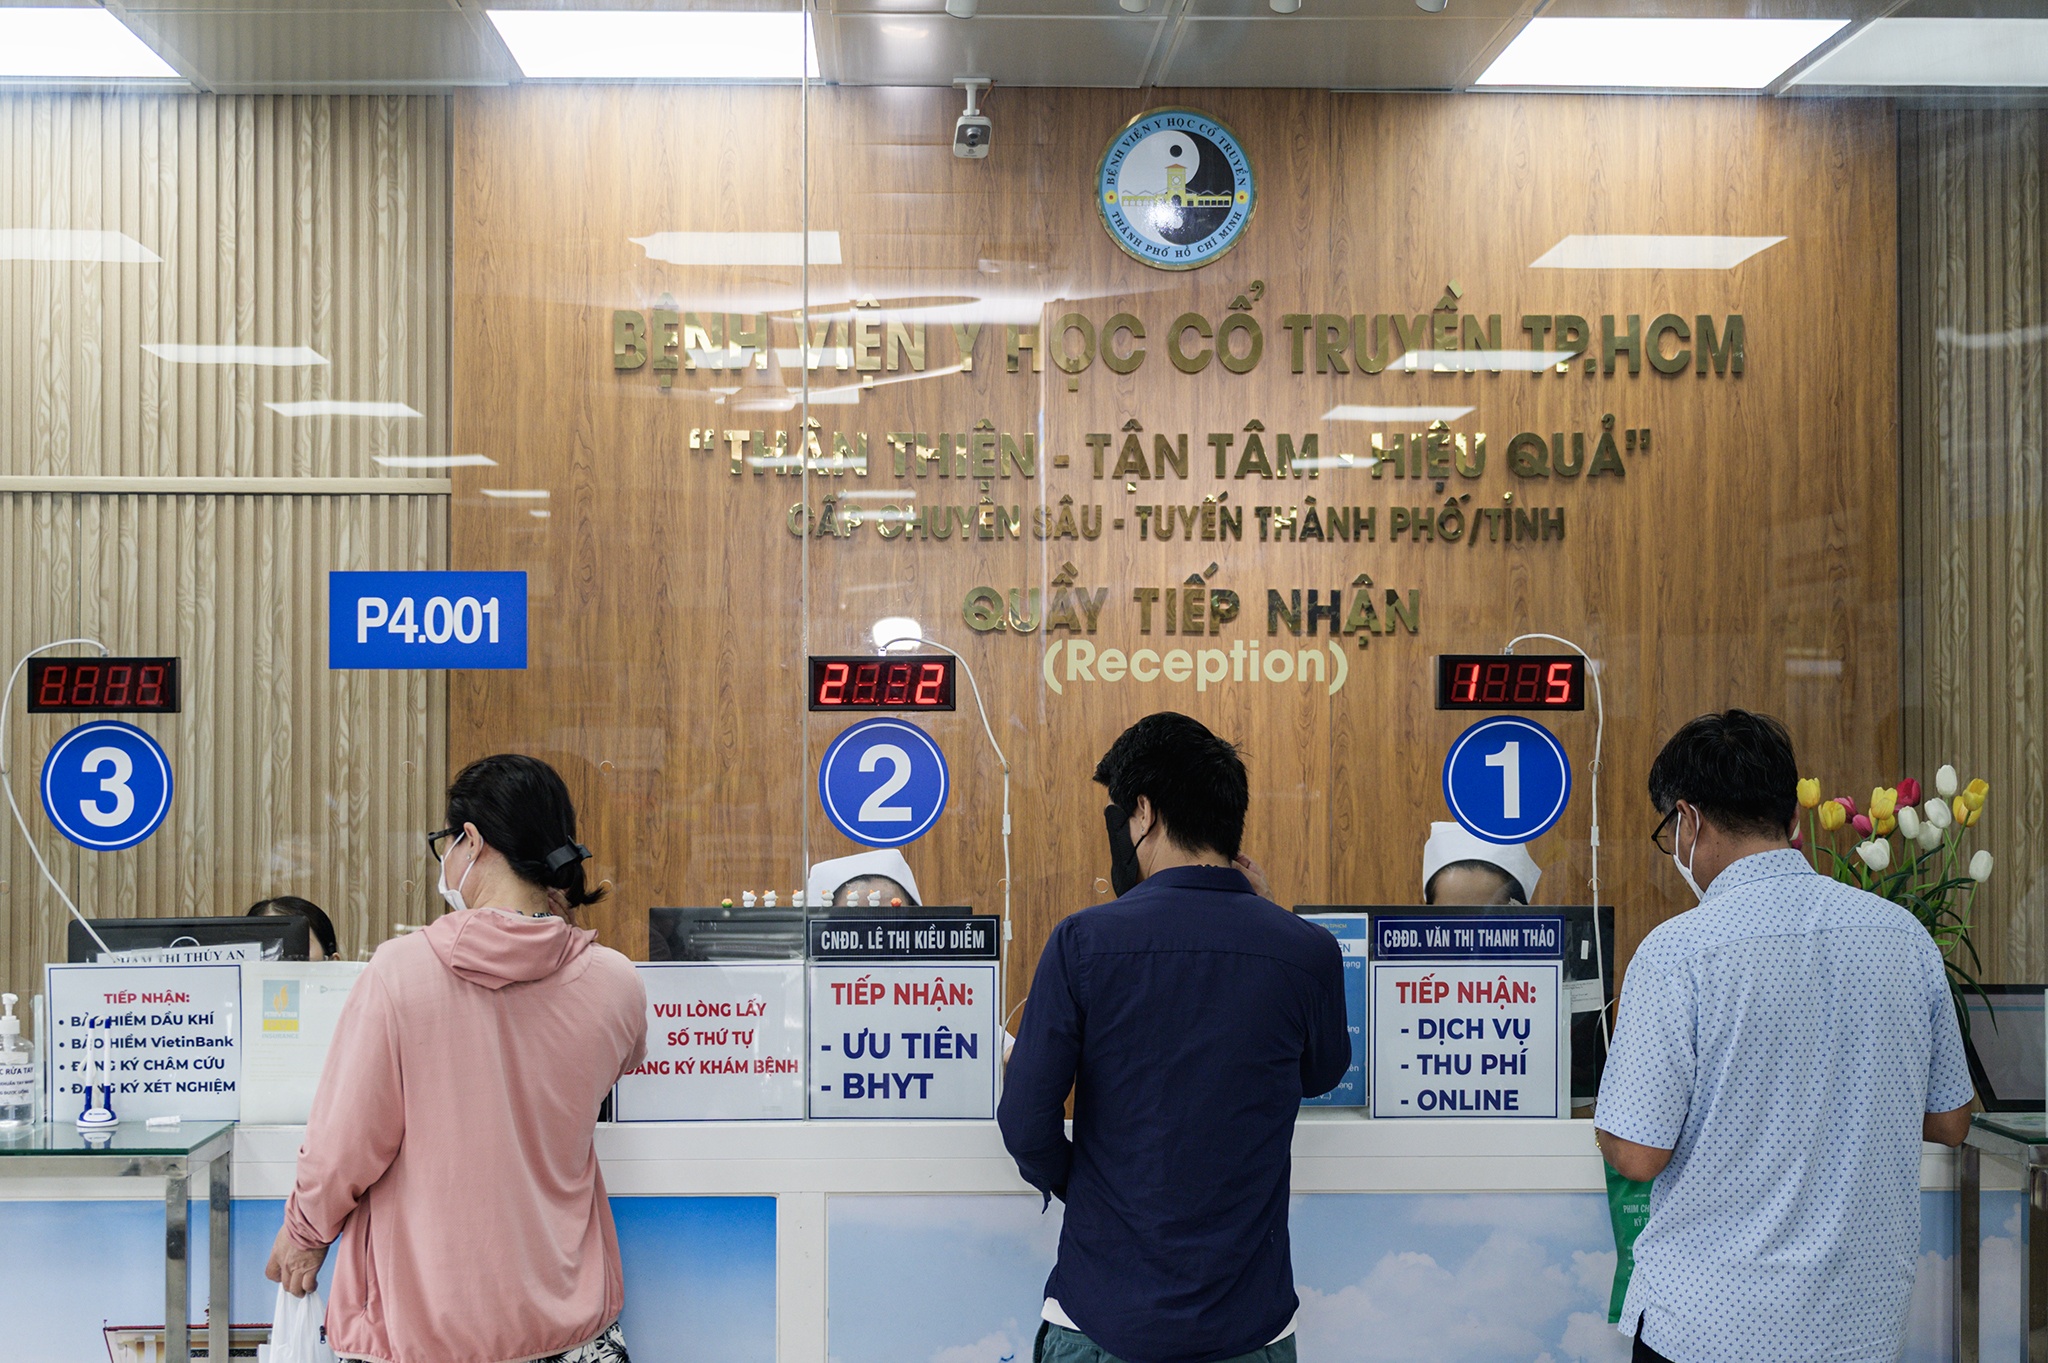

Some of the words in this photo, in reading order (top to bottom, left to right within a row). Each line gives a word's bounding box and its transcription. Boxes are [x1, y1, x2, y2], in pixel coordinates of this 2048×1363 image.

[1106, 149, 1125, 185] BỆNH
[1122, 127, 1152, 148] VIỆN
[1154, 119, 1162, 129] Y
[1167, 117, 1196, 129] HỌC
[1145, 245, 1170, 258] PHỐ
[1197, 236, 1218, 253] CHÍ
[1218, 211, 1243, 239] MINH
[613, 292, 768, 388] BỆNH
[793, 292, 926, 389] VIỆN
[949, 311, 984, 372] Y
[1007, 311, 1147, 392] HỌC
[1168, 279, 1264, 375] CỔ
[1283, 279, 1502, 375] TRUYỀN
[1522, 313, 1746, 376] TP.HCM
[887, 418, 1035, 491] THIỆN
[1085, 418, 1189, 494] TẬN
[1207, 418, 1320, 479] TÂM
[1371, 418, 1487, 493] HIỆU
[875, 494, 1021, 539] CHUYÊN
[1032, 494, 1103, 539] SÂU
[1135, 490, 1243, 541] TUYẾN
[1254, 495, 1376, 542] THÀNH
[356, 596, 501, 644] P4.001
[962, 561, 1109, 634] QUẦY
[1133, 561, 1241, 634] TIẾP
[1267, 573, 1420, 648] NHẬN
[1043, 639, 1349, 696] (Reception)
[79, 746, 135, 828] 3
[858, 743, 913, 822] 2
[1485, 741, 1521, 819] 1
[868, 926, 884, 950] LÊ
[887, 929, 910, 954] THỊ
[915, 923, 946, 950] KIỀU
[950, 922, 985, 949] DIỄM
[1425, 926, 1451, 948] VĂN
[1453, 928, 1475, 951] THỊ
[1477, 928, 1519, 948] THANH
[1522, 924, 1555, 948] THẢO
[184, 949, 223, 963] THÚY
[225, 949, 246, 961] AN
[104, 989, 137, 1004] TIẾP
[141, 989, 190, 1006] NHẬN:
[830, 974, 886, 1006] TIẾP
[893, 976, 974, 1012] NHẬN:
[1395, 973, 1450, 1004] TIẾP
[1457, 975, 1537, 1010] NHẬN:
[109, 1011, 147, 1026] HIỂM
[151, 1011, 183, 1025] DẦU
[188, 1011, 215, 1025] KHÍ
[653, 1003, 682, 1018] VUI
[686, 999, 731, 1018] LÒNG
[736, 998, 767, 1017] LẤY
[110, 1034, 147, 1048] HIỂM
[151, 1035, 234, 1048] VietinBank
[667, 1027, 690, 1046] SỐ
[694, 1027, 729, 1046] THỨ
[732, 1028, 754, 1049] TỰ
[842, 1027, 891, 1060] ƯU
[901, 1026, 978, 1060] TIÊN
[1417, 1018, 1484, 1045] DỊCH
[1492, 1018, 1531, 1045] VỤ
[120, 1056, 140, 1071] KÝ
[143, 1056, 189, 1071] CHÂM
[193, 1056, 225, 1071] CỨU
[675, 1056, 696, 1075] KÝ
[700, 1056, 749, 1075] KHÁM
[753, 1056, 798, 1077] BỆNH
[1416, 1054, 1472, 1076] THU
[1481, 1048, 1528, 1075] PHÍ
[120, 1079, 140, 1094] KÝ
[144, 1079, 173, 1094] XÉT
[176, 1078, 236, 1095] NGHIỆM
[842, 1073, 934, 1100] BHYT
[1416, 1089, 1519, 1111] ONLINE
